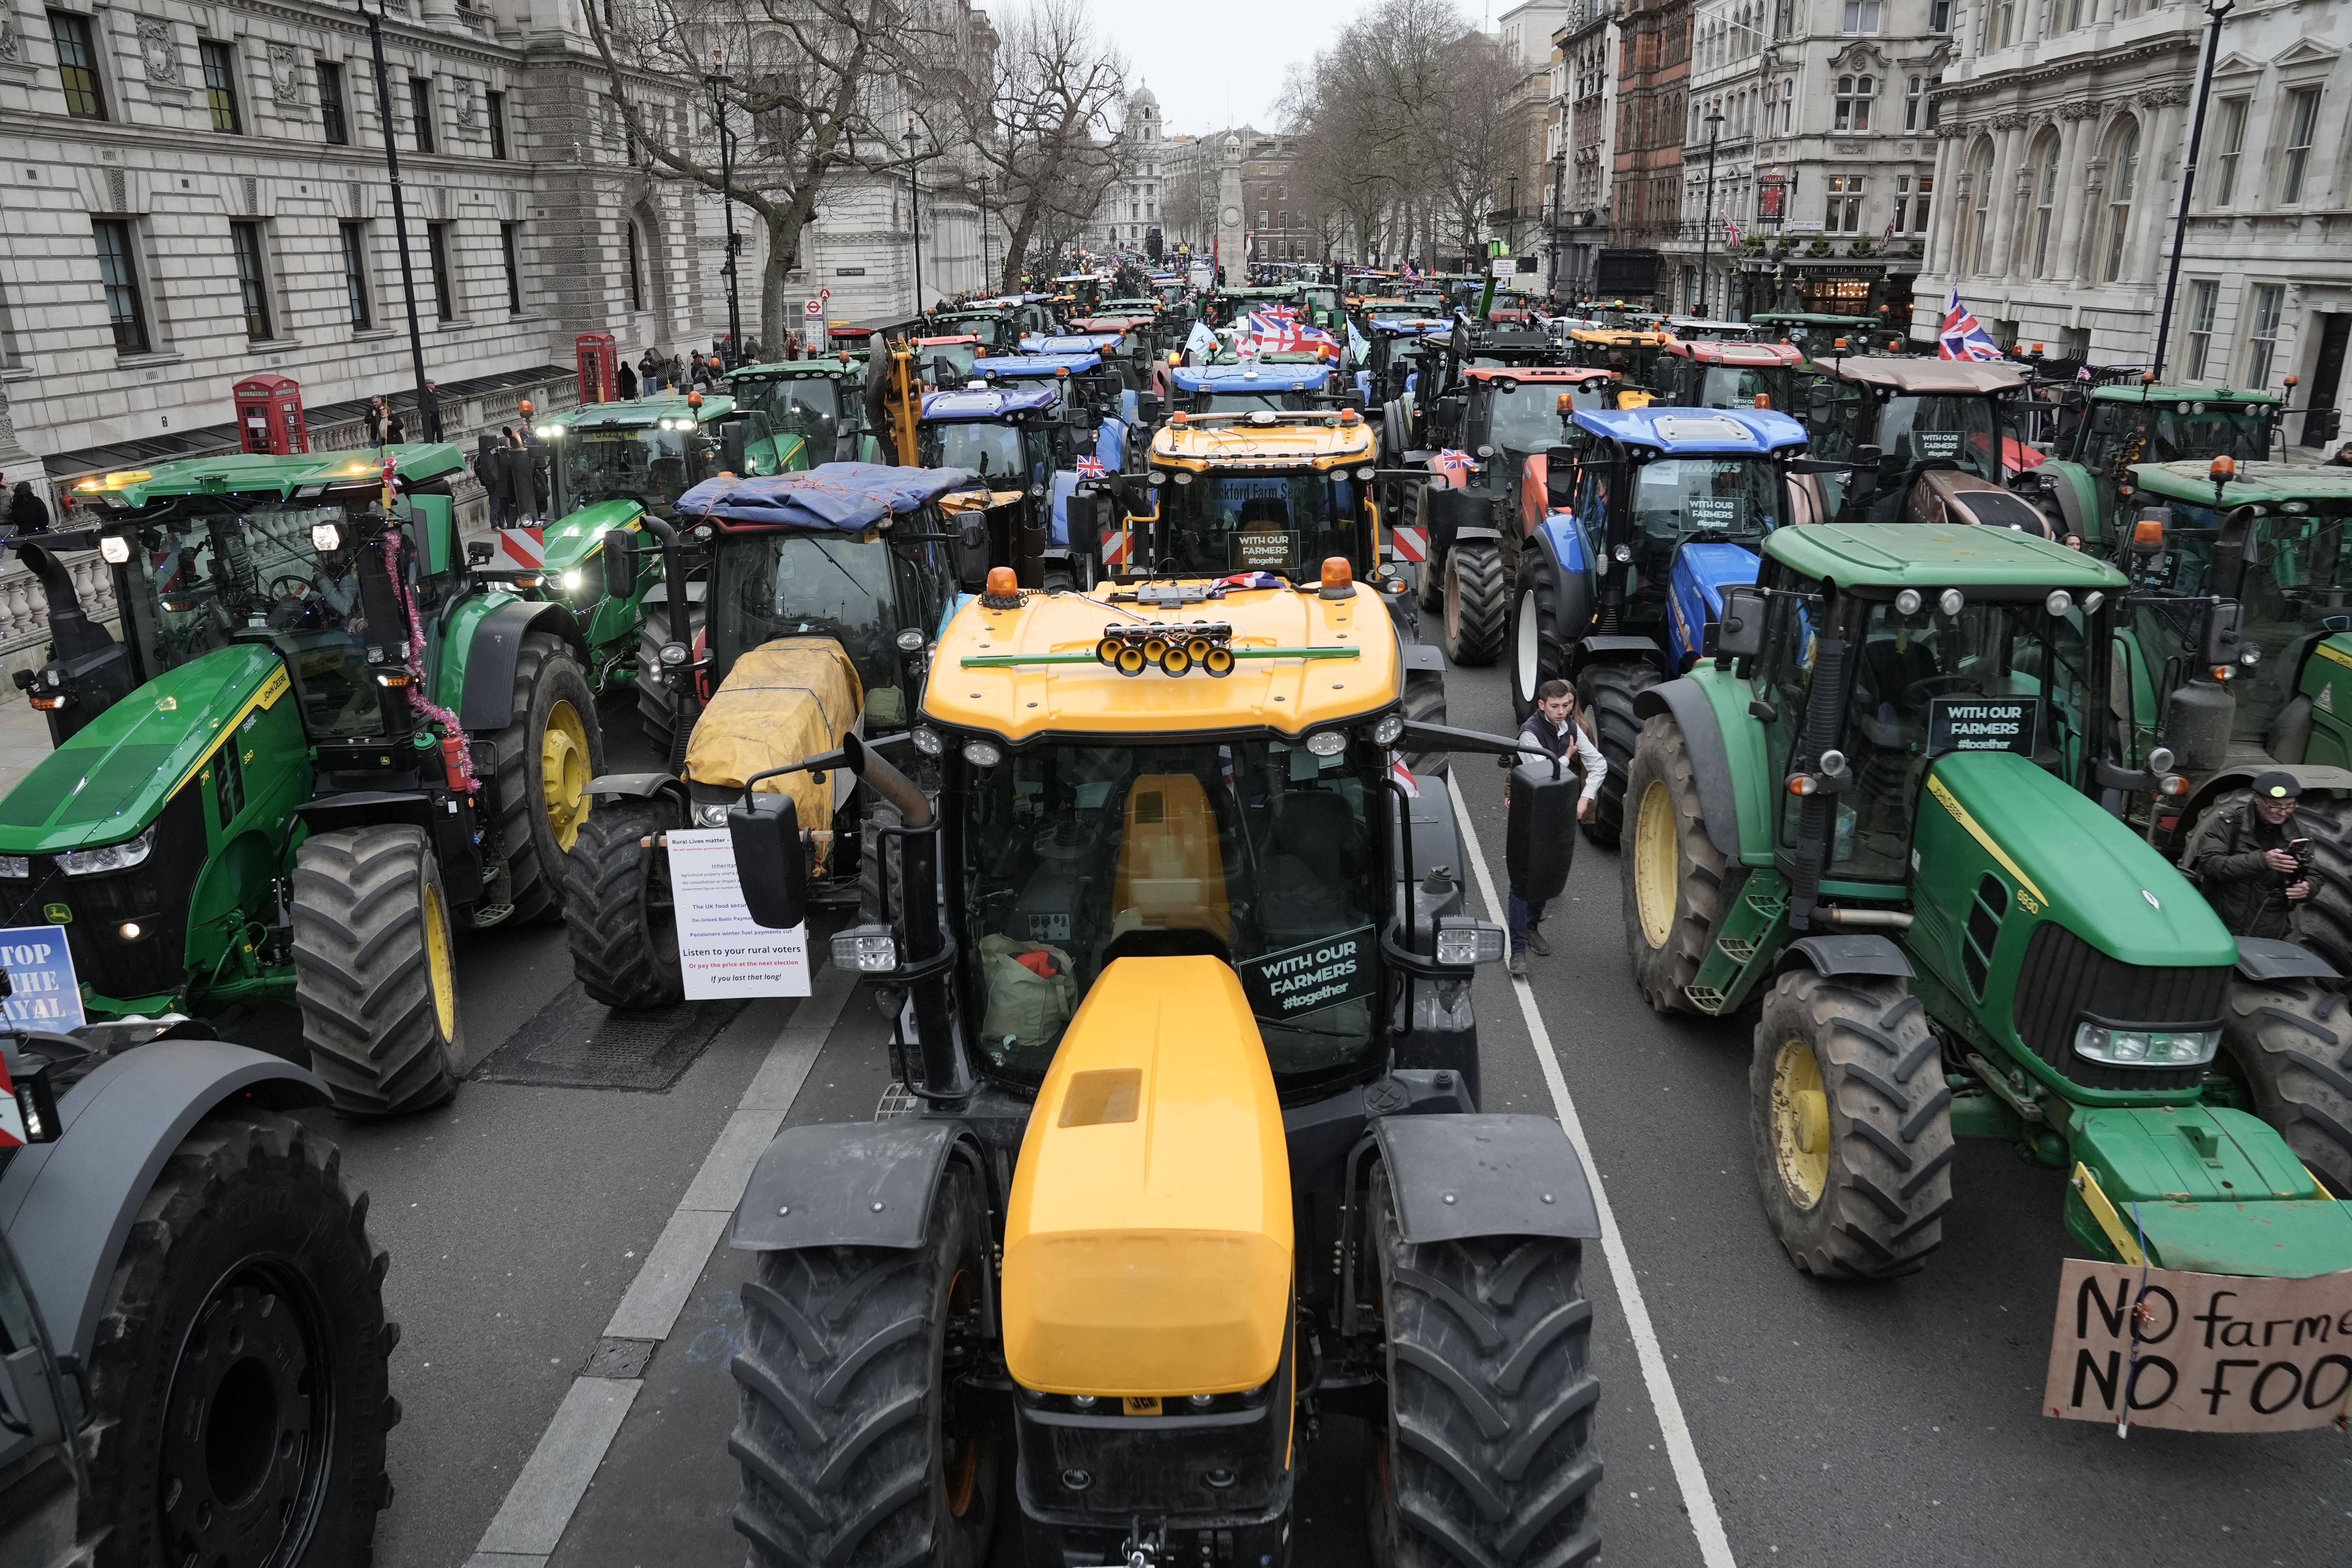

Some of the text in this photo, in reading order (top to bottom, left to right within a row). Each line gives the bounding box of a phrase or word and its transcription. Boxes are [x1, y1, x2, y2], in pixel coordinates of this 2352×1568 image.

[822, 290, 828, 298] A
[1681, 462, 1742, 473] HAYNES
[1253, 483, 1278, 498] Farm
[1689, 500, 1734, 509] WITH OUR
[1692, 510, 1733, 519] FARMERS
[1697, 519, 1730, 528] #together
[1238, 535, 1289, 544] WITH OUR
[1242, 546, 1289, 555] FARMERS
[1248, 556, 1283, 566] #together
[264, 673, 287, 702] JOHN DEERE
[1947, 706, 2022, 719] WITH OUR
[1950, 722, 2019, 735] FARMERS
[1957, 739, 2011, 750] #together
[243, 749, 254, 765] 330
[201, 769, 210, 786] 7R
[1932, 785, 1962, 823] JOHN DEERE
[2016, 889, 2039, 915] 6930
[0, 944, 51, 967] TOP
[724, 948, 745, 956] your
[1261, 941, 1357, 979] WITH OUR
[8, 971, 60, 993] THE
[711, 975, 717, 984] If
[717, 975, 731, 983] you
[764, 973, 782, 982] long!
[1270, 960, 1357, 996] FARMERS
[1283, 982, 1349, 1010] #together
[2077, 1276, 2179, 1344] NO
[2071, 1348, 2352, 1415] NO FOO
[1132, 1396, 1157, 1410] JCB
